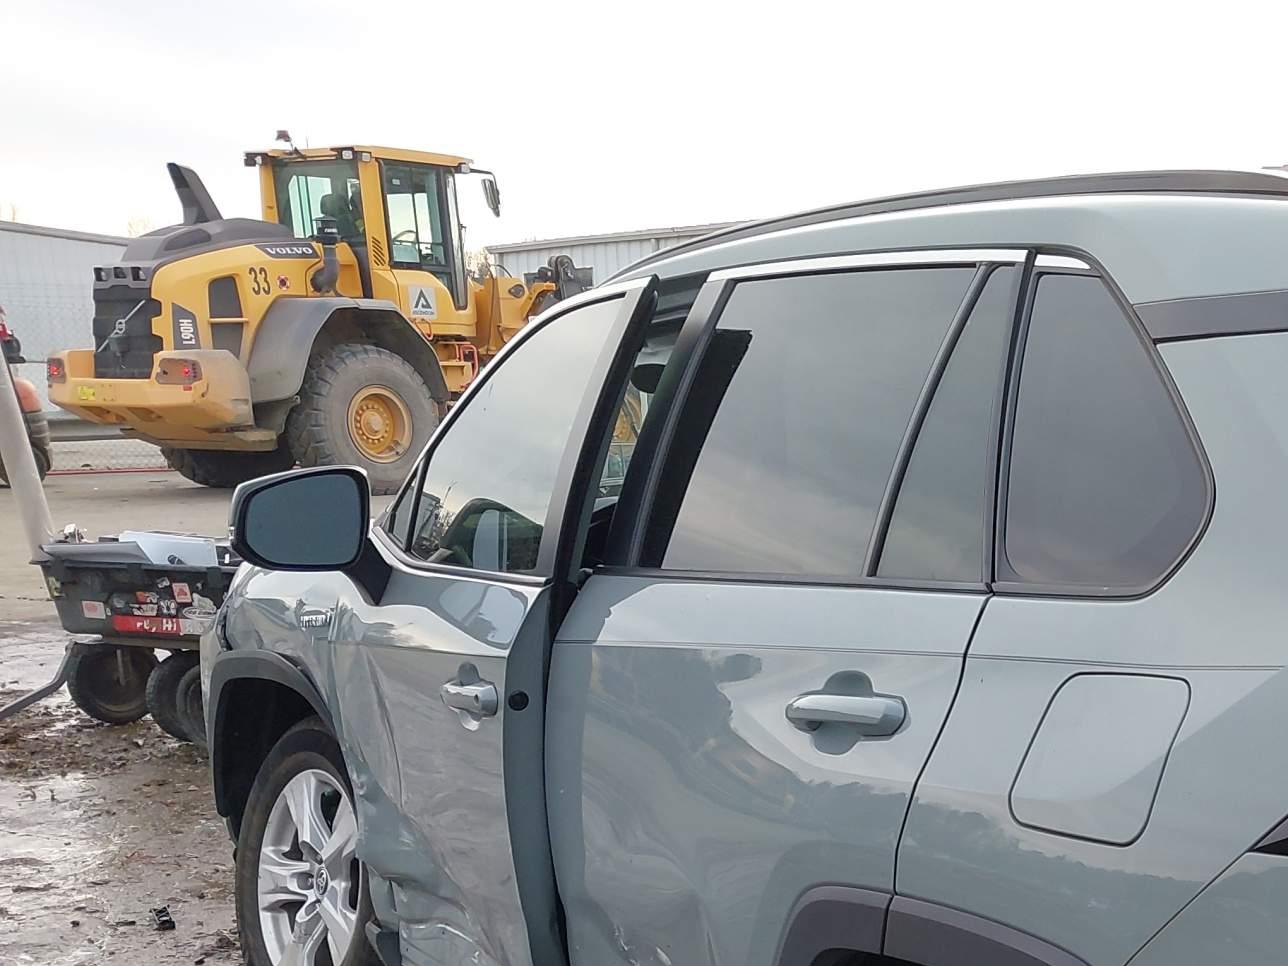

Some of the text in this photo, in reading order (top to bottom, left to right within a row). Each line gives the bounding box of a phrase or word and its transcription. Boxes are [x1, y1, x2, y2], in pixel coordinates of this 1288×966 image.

[264, 246, 313, 255] VOLVO
[248, 266, 271, 296] 33
[178, 319, 196, 345] L90H
